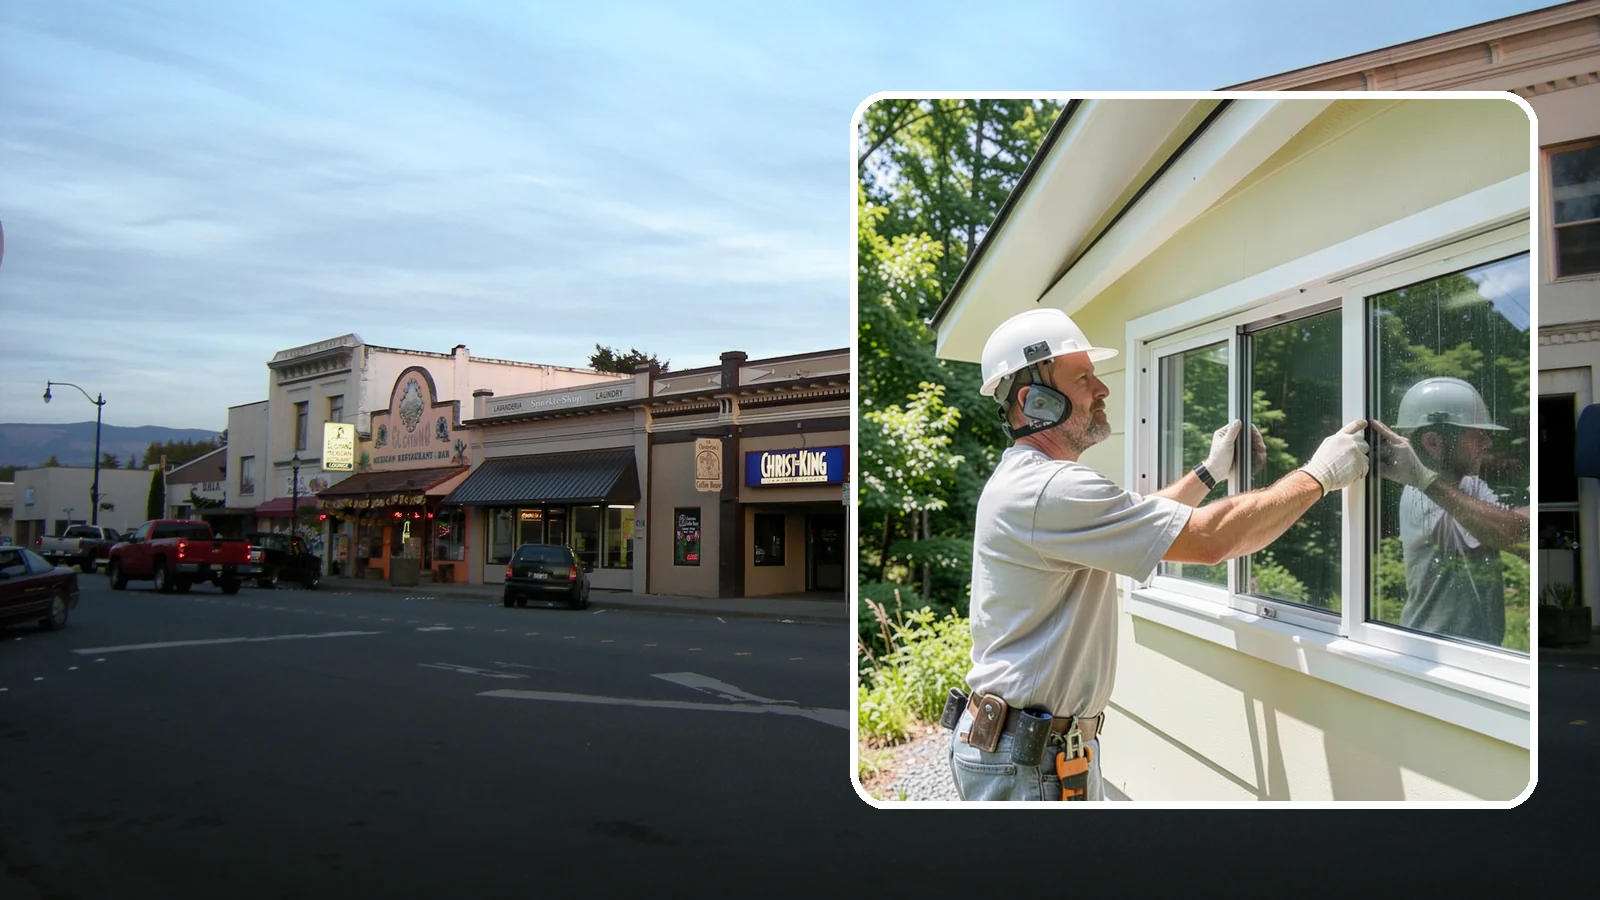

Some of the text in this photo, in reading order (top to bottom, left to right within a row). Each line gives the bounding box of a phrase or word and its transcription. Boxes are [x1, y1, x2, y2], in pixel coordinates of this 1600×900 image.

[595, 389, 623, 400] LAUNDRY
[493, 402, 522, 412] LAVANDERIA
[531, 394, 582, 408] Sparkle Shop
[373, 455, 396, 464] MEXICAN
[397, 451, 433, 462] RESTAURANT
[437, 450, 450, 459] BAR
[761, 450, 827, 478] CHRIST KING
[696, 480, 709, 489] Coffee
